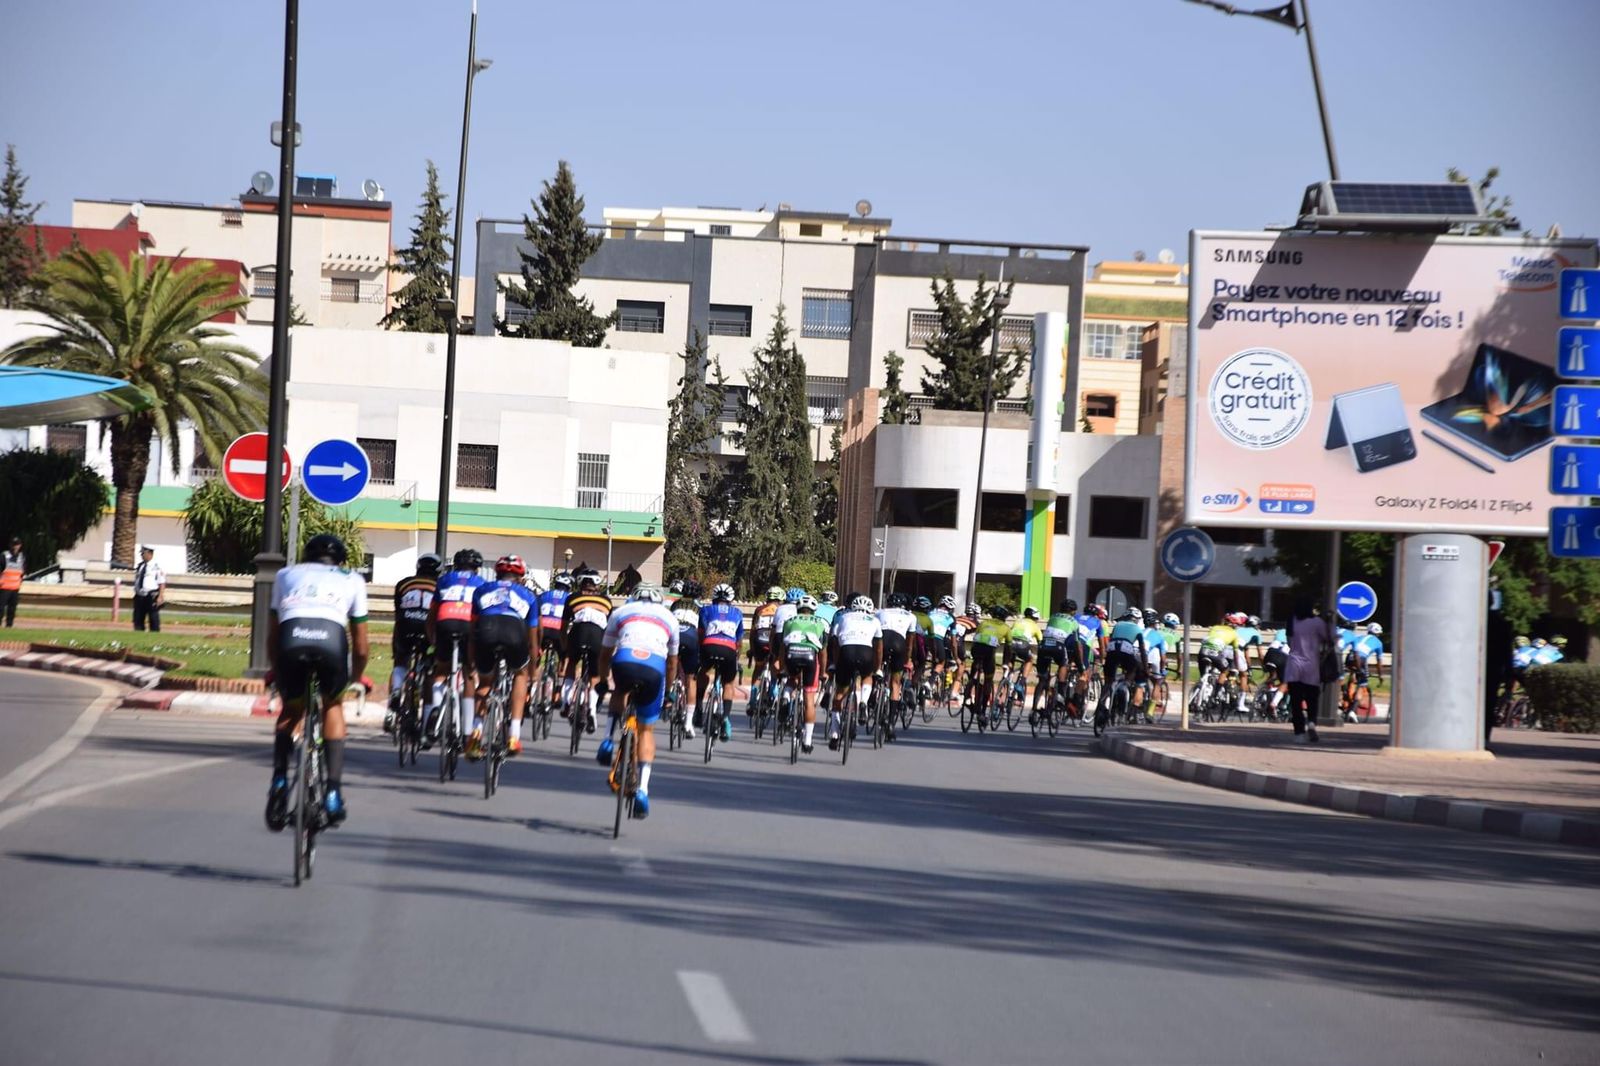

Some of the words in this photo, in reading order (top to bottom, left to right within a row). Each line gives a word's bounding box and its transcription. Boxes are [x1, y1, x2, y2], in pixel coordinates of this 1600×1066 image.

[1213, 248, 1304, 265] SAMSUNG
[1213, 278, 1281, 303] Payez
[1284, 283, 1340, 300] votre
[1345, 287, 1441, 304] nouveau
[1211, 301, 1348, 328] Smartphone
[1353, 312, 1380, 327] en
[1385, 308, 1407, 328] 12
[1412, 307, 1453, 329] fois
[1457, 310, 1464, 329] !
[1225, 371, 1295, 391] Crédit
[1202, 493, 1239, 505] e-SIM
[1375, 496, 1427, 511] Galaxy
[1428, 497, 1437, 509] Z
[1439, 498, 1478, 510] Fold4
[1488, 499, 1497, 511] Z
[1500, 500, 1533, 514] Flip4
